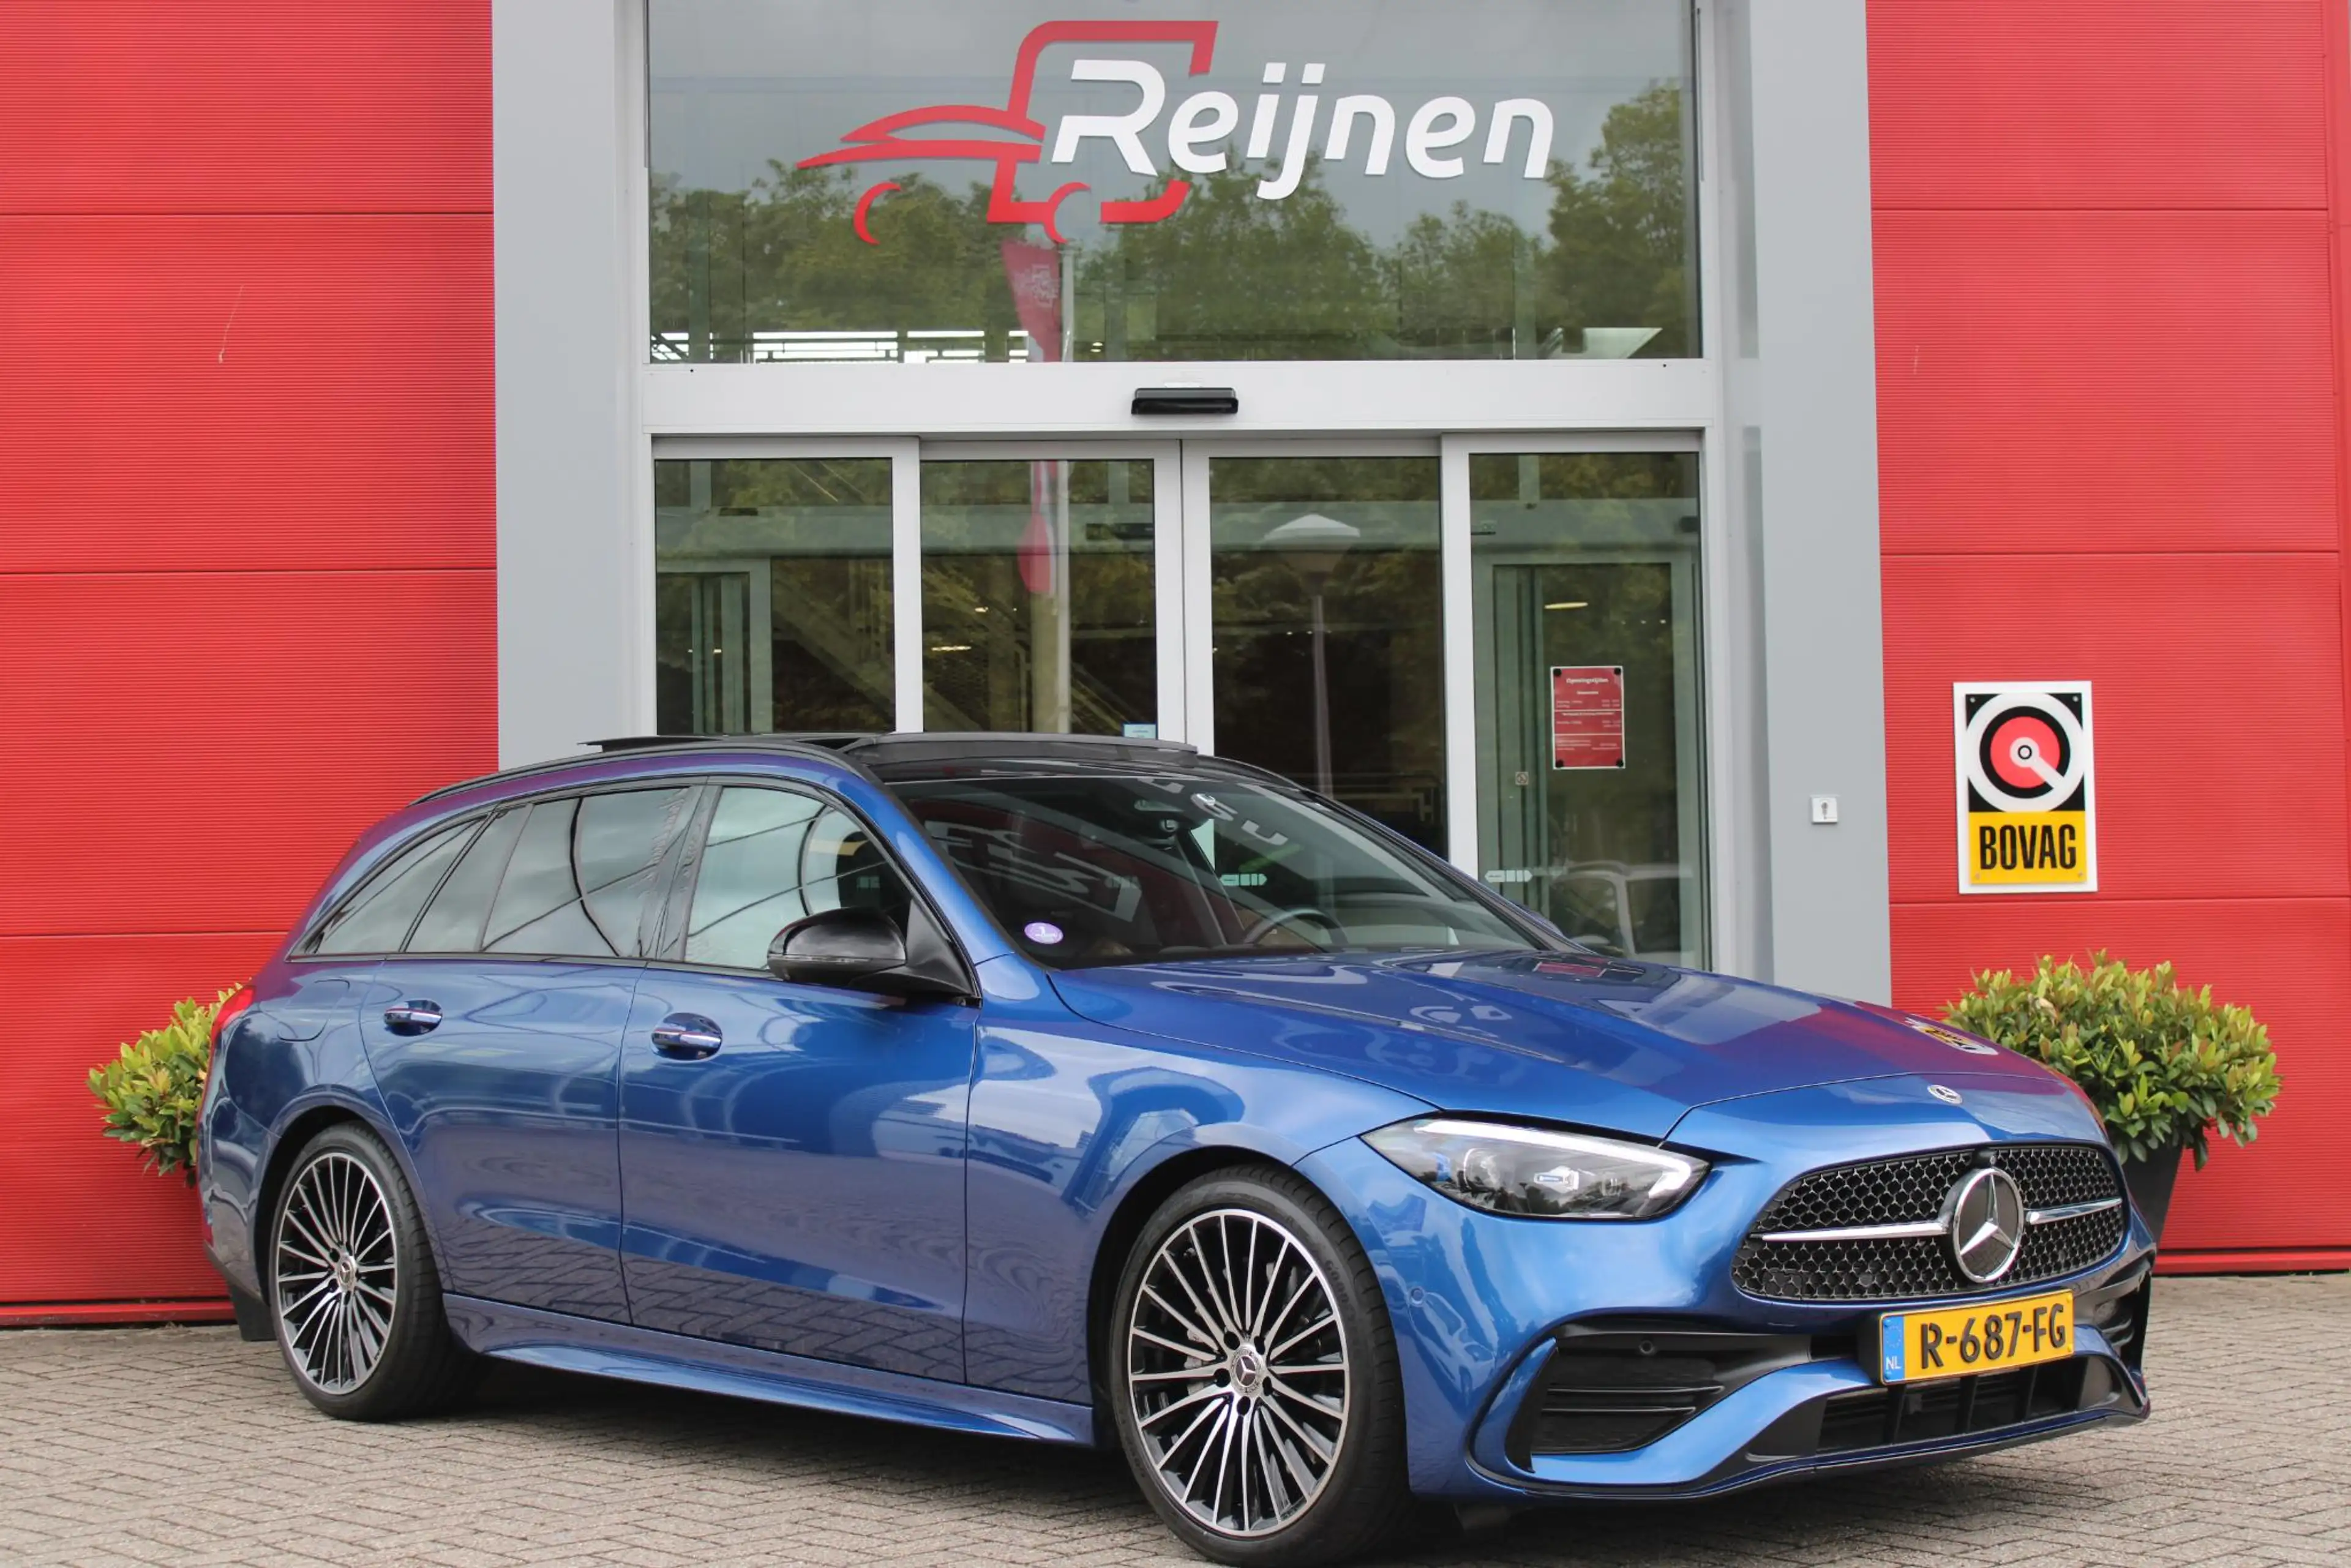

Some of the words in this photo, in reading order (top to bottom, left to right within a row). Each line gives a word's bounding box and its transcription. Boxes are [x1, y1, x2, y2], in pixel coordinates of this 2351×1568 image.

[1051, 59, 1554, 200] Reijnen
[1979, 824, 2077, 870] BOVAG
[1885, 1355, 1902, 1370] NL
[1921, 1303, 2066, 1369] R-687-FG
